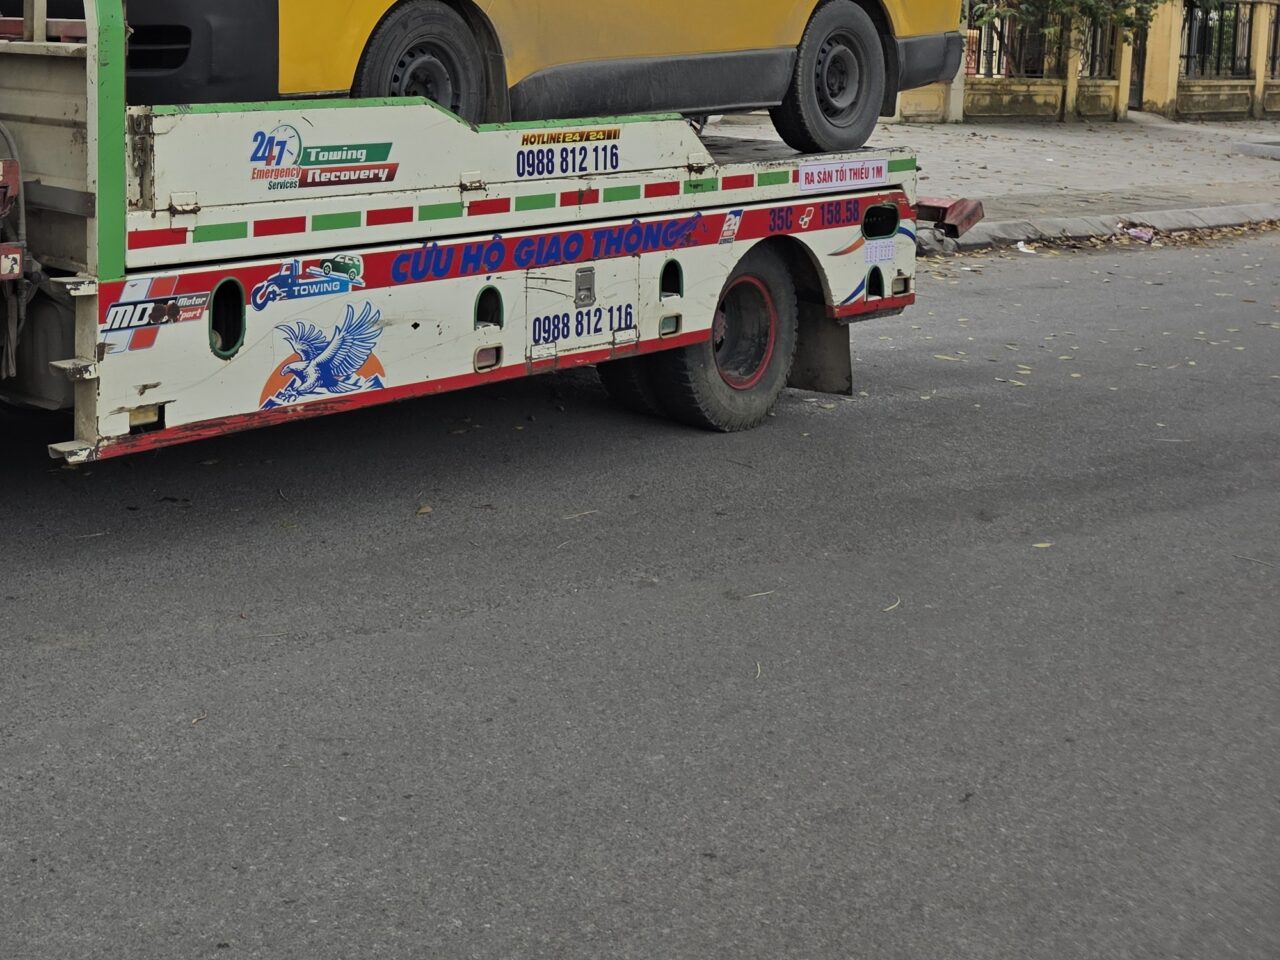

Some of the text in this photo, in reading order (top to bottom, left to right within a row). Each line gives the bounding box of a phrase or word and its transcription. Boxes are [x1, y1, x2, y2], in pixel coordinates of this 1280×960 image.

[522, 132, 563, 146] HOTLINE
[307, 147, 367, 162] Towing
[517, 144, 619, 177] 0988 812 116
[251, 167, 389, 183] Emergency Recovery
[804, 171, 815, 185] RA
[871, 165, 883, 180] 1M
[267, 180, 298, 190] Services
[769, 200, 860, 233] 35C 158.58
[391, 239, 453, 283] CỨU
[460, 233, 507, 281] HỘ
[513, 238, 585, 268] GIAO
[293, 280, 341, 296] TOWING
[178, 296, 207, 307] Motor
[177, 308, 202, 322] port
[532, 304, 633, 344] 0988 812 116
